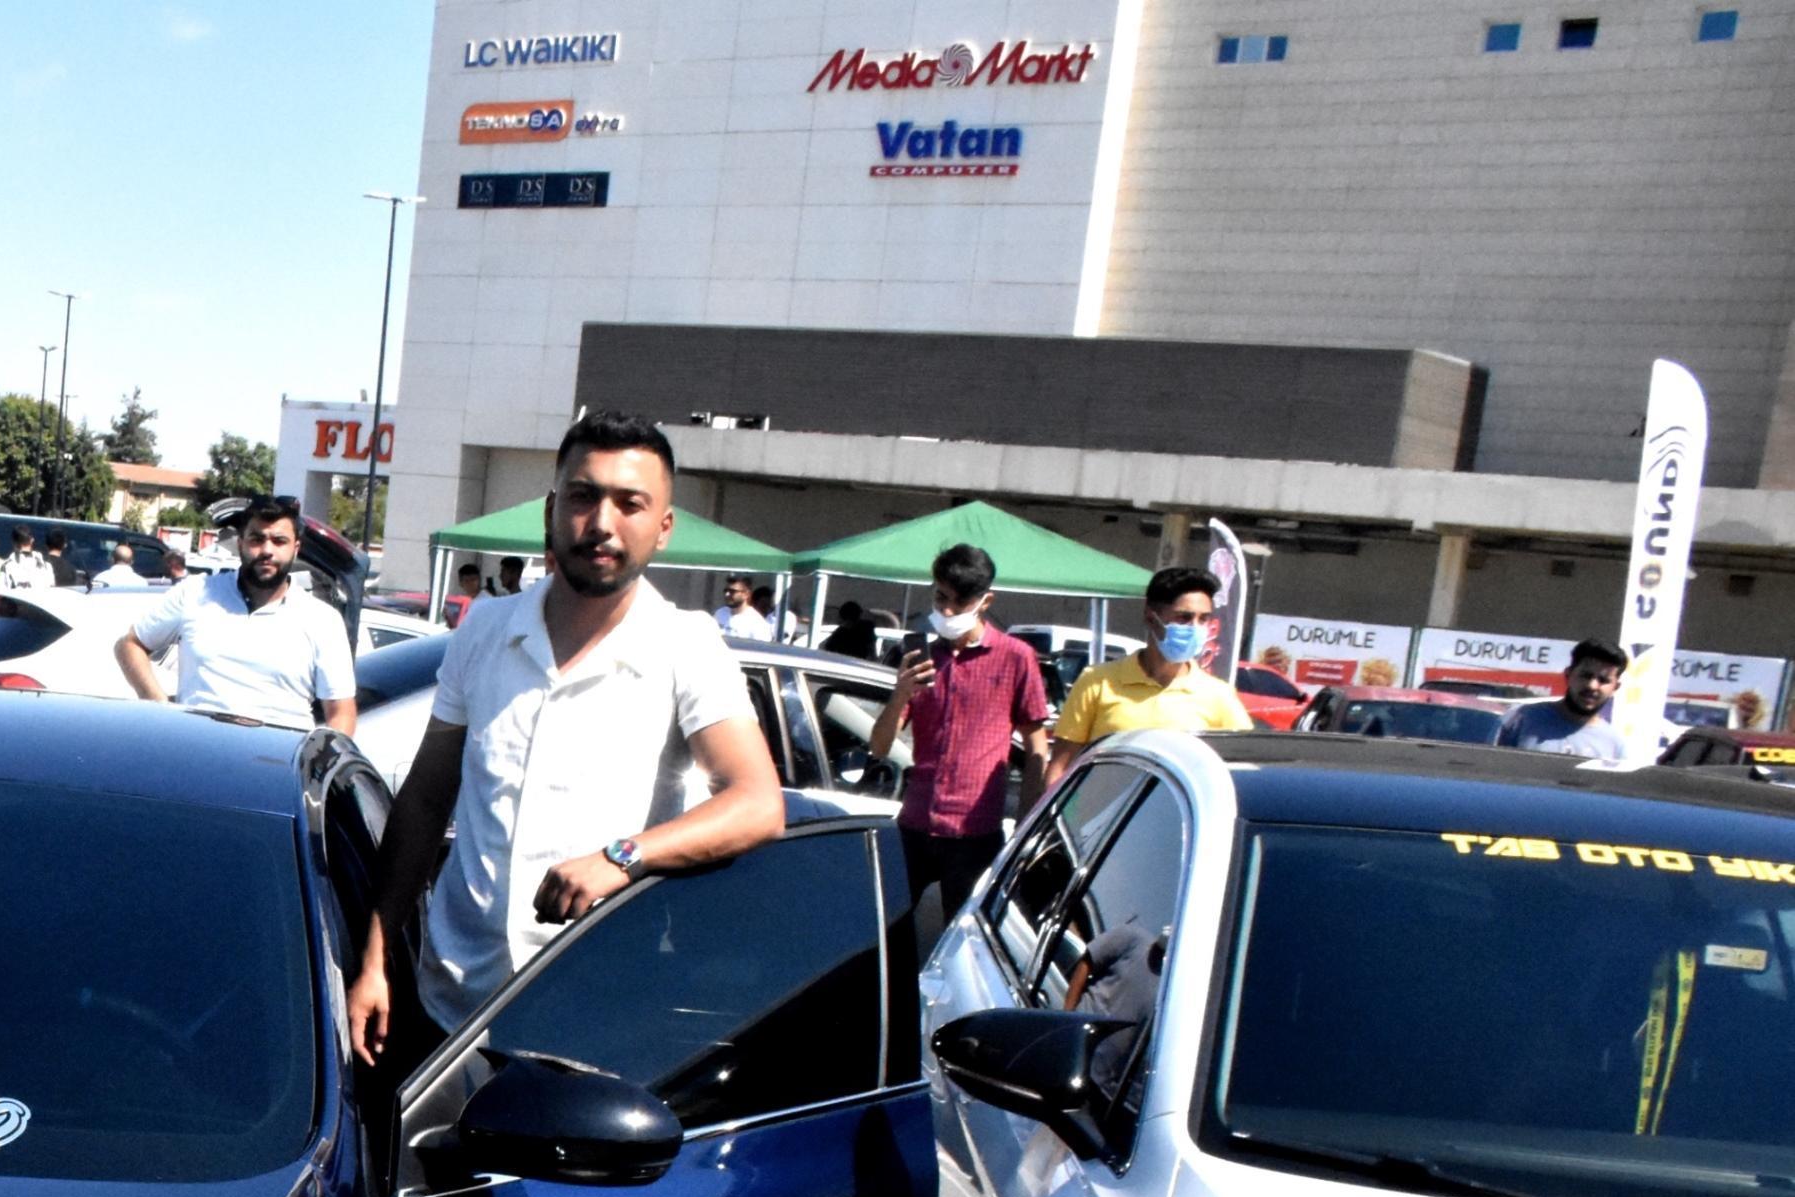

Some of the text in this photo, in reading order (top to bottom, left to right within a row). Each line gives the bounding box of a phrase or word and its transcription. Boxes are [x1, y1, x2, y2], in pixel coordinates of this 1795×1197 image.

[464, 41, 499, 68] LC
[807, 41, 1094, 91] Media Markt
[464, 111, 564, 131] TEKNOSA
[876, 120, 1022, 159] Vatan
[875, 166, 1010, 176] COMPUTER
[313, 420, 395, 462] FLO
[1576, 843, 1694, 872] OTO
